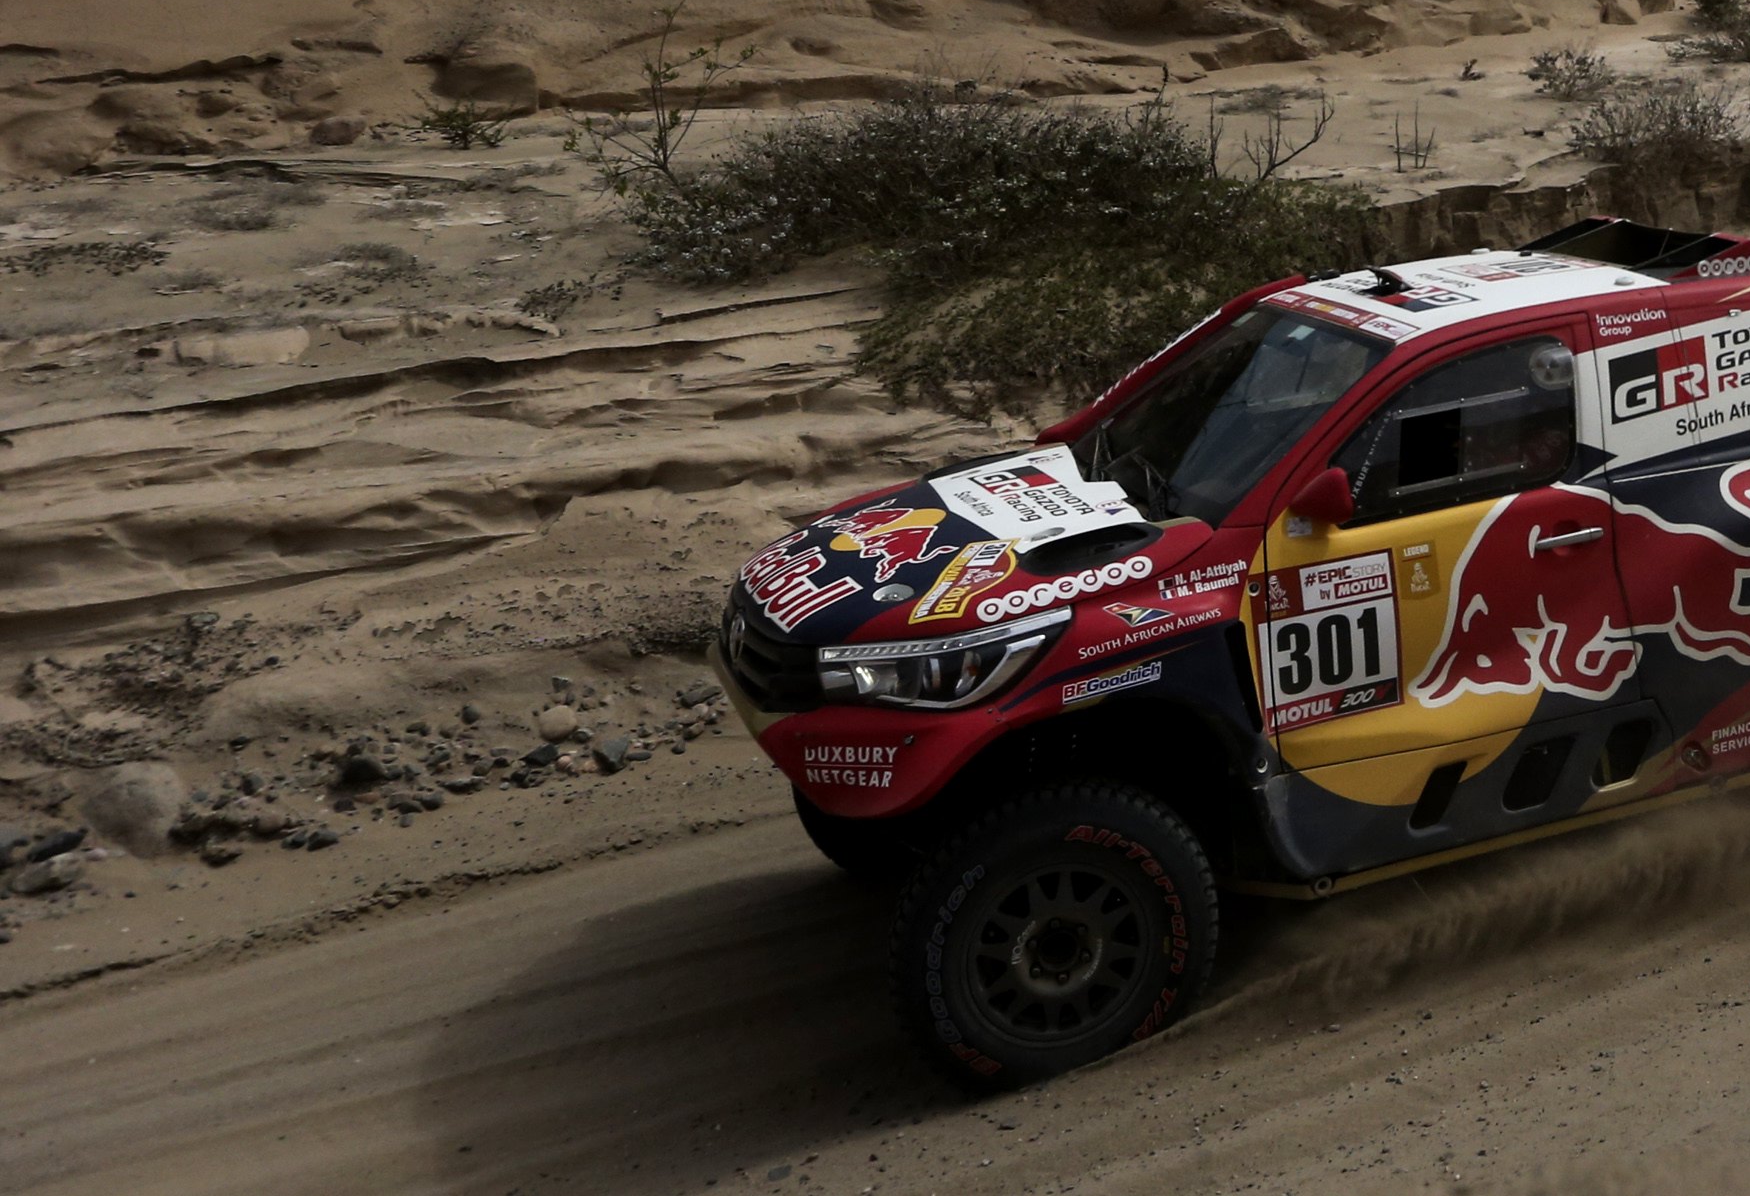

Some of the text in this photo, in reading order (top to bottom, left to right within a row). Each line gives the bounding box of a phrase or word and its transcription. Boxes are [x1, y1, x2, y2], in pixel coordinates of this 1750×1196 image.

[1599, 326, 1632, 337] Group
[1613, 363, 1706, 419] GR
[1676, 410, 1725, 436] South
[1000, 493, 1042, 522] Racing
[1023, 489, 1069, 517] GAZOO
[1048, 484, 1096, 515] TOYOTA
[1175, 559, 1248, 586] N. Al-Attiyah
[1176, 574, 1240, 598] M. Baumel
[976, 556, 1153, 623] ooredoo
[1319, 576, 1386, 600] by MOTUL
[1078, 607, 1222, 660] SOUTH AFRICAN AIRWAYS
[1277, 607, 1381, 695] 301
[1063, 662, 1162, 701] BFGoodrich
[1270, 697, 1333, 728] MOTUL
[804, 746, 898, 763] DUXBURY
[806, 768, 893, 788] NETGEAR
